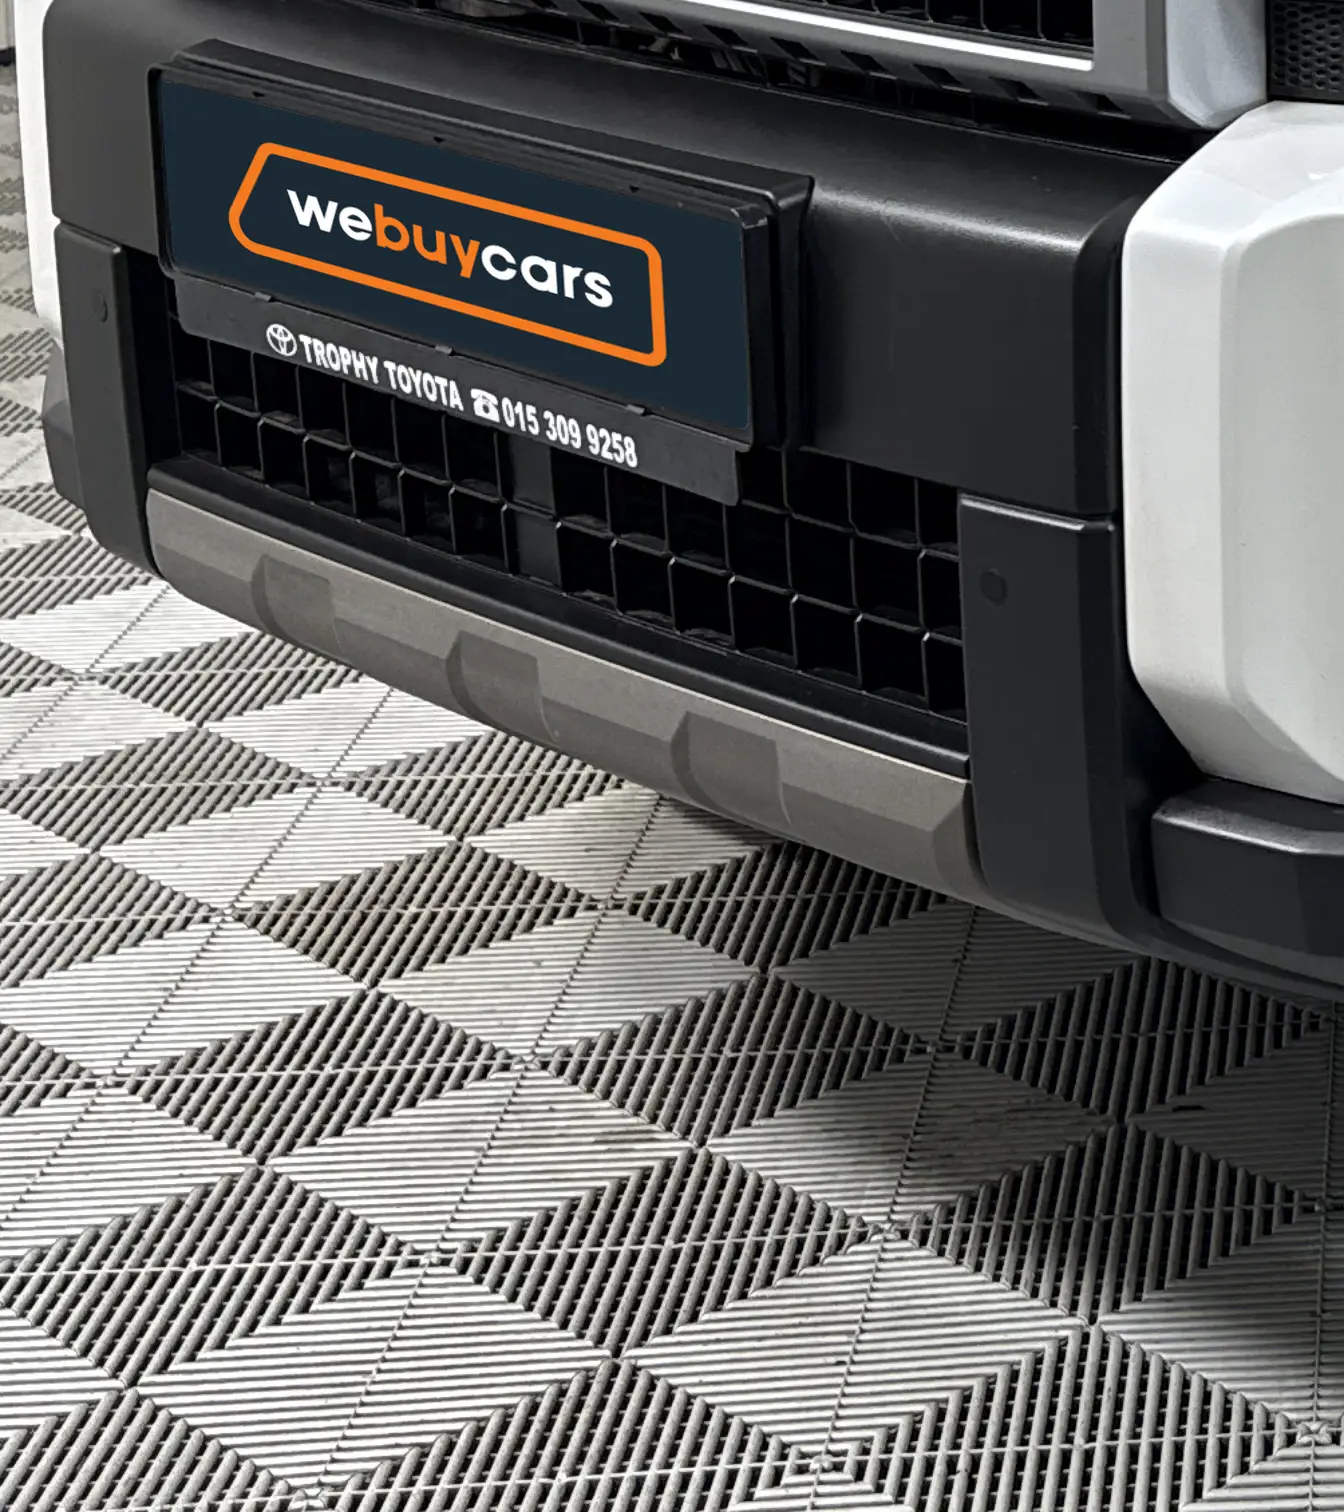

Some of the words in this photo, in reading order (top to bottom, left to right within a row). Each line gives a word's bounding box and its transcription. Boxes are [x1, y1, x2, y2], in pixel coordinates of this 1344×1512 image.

[286, 188, 614, 309] webuycars
[297, 333, 380, 385] TROPHY
[382, 359, 464, 412] TOYOTA
[502, 396, 540, 436] 015
[542, 410, 582, 450] 309
[585, 423, 638, 468] 9258
